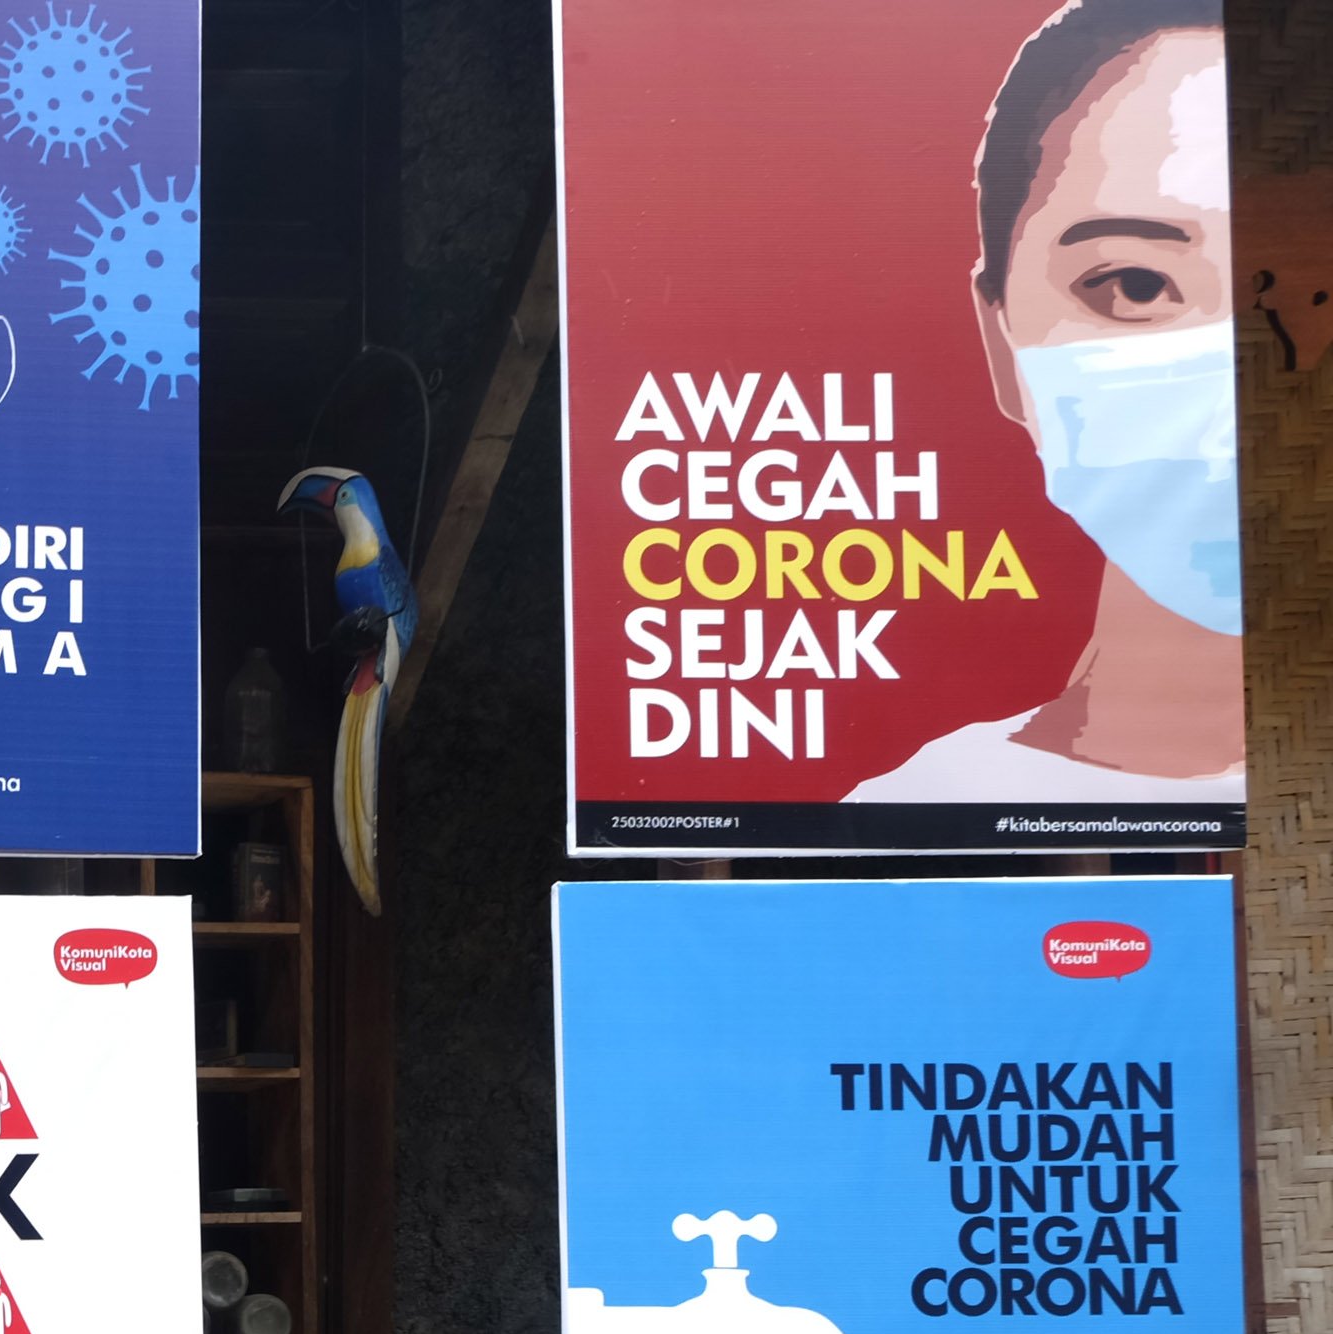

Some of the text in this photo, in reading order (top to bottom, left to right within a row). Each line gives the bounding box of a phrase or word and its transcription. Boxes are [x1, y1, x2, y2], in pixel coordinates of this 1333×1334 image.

[614, 371, 894, 443] AWALI
[621, 449, 939, 522] CEGAH
[622, 528, 1039, 603] CORONA
[624, 607, 900, 682] SEJAK
[629, 687, 825, 761] DINI
[611, 816, 740, 829] 25032002POSTER#1
[996, 817, 1222, 835] #kitabersamalawancorona
[60, 945, 152, 960] KomuniKota
[60, 958, 106, 972] Visual
[1049, 938, 1146, 953] KomuniKota
[1049, 952, 1098, 966] Visual
[829, 1062, 1173, 1111] TINDAKAN
[928, 1113, 1175, 1163] MUDAH
[948, 1164, 1182, 1214] UNTUK
[958, 1216, 1178, 1265] CEGAH
[911, 1267, 1185, 1317] CORONA
